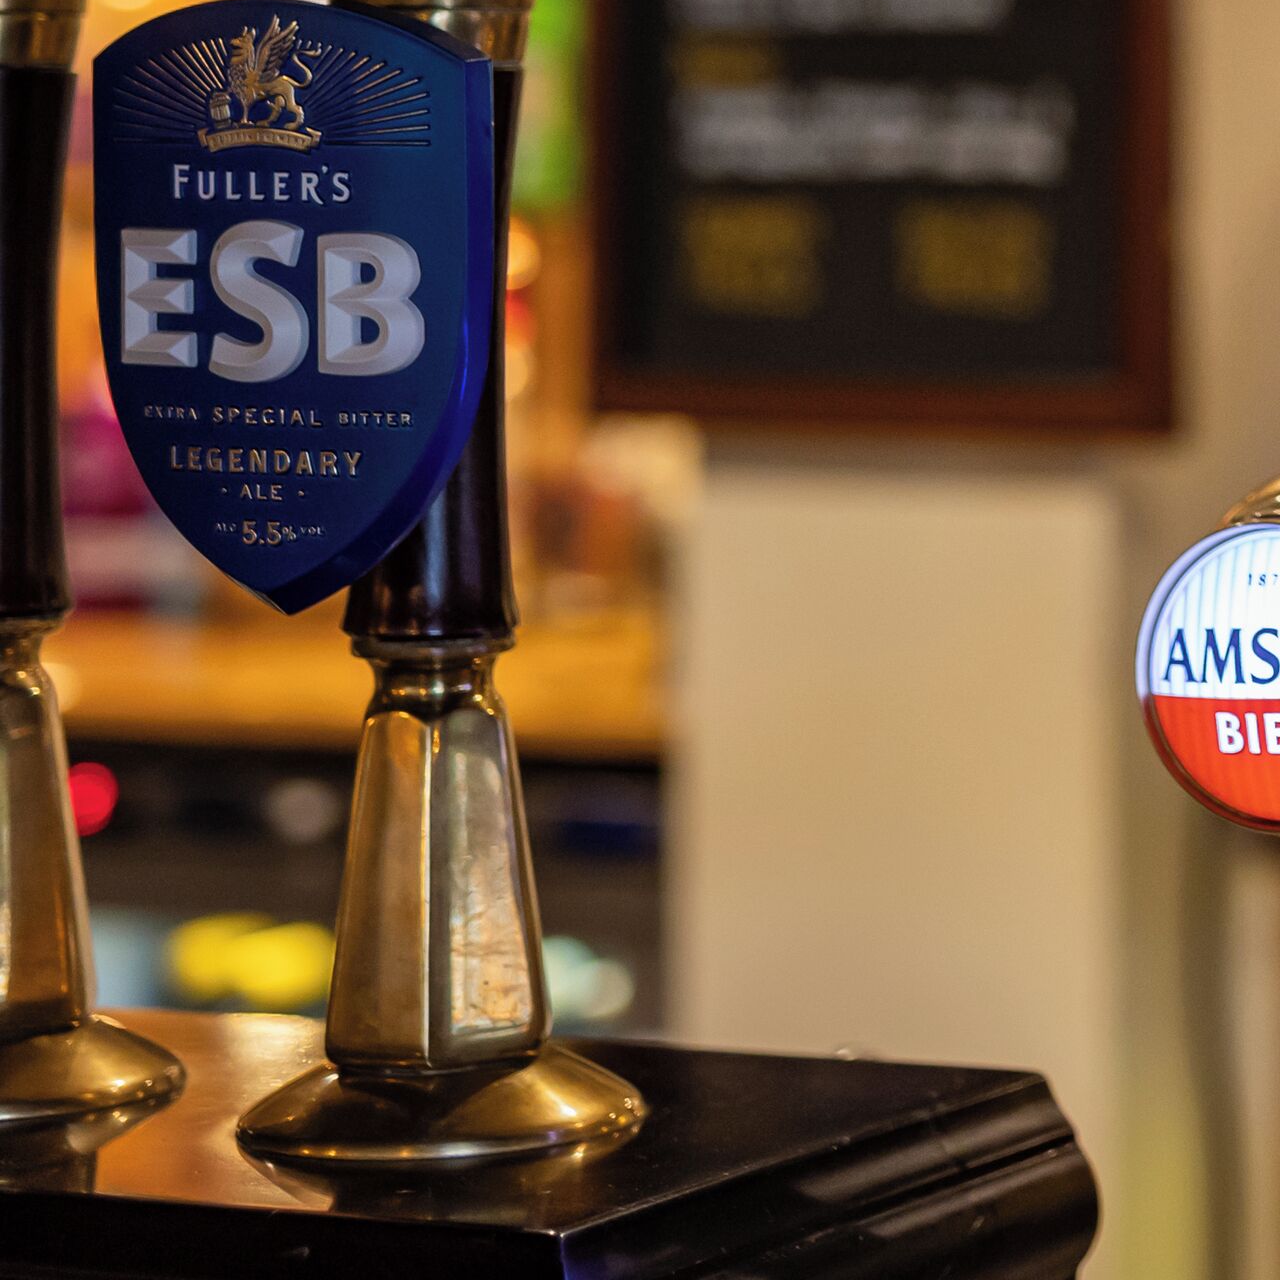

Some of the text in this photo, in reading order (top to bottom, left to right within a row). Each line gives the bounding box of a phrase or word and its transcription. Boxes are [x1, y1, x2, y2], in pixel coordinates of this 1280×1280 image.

[174, 164, 350, 204] FULLER'S
[121, 219, 425, 383] ESB
[144, 405, 413, 426] EXTRA SPECIAL BITTER
[170, 445, 362, 476] LEGENDARY
[240, 484, 283, 500] ALE
